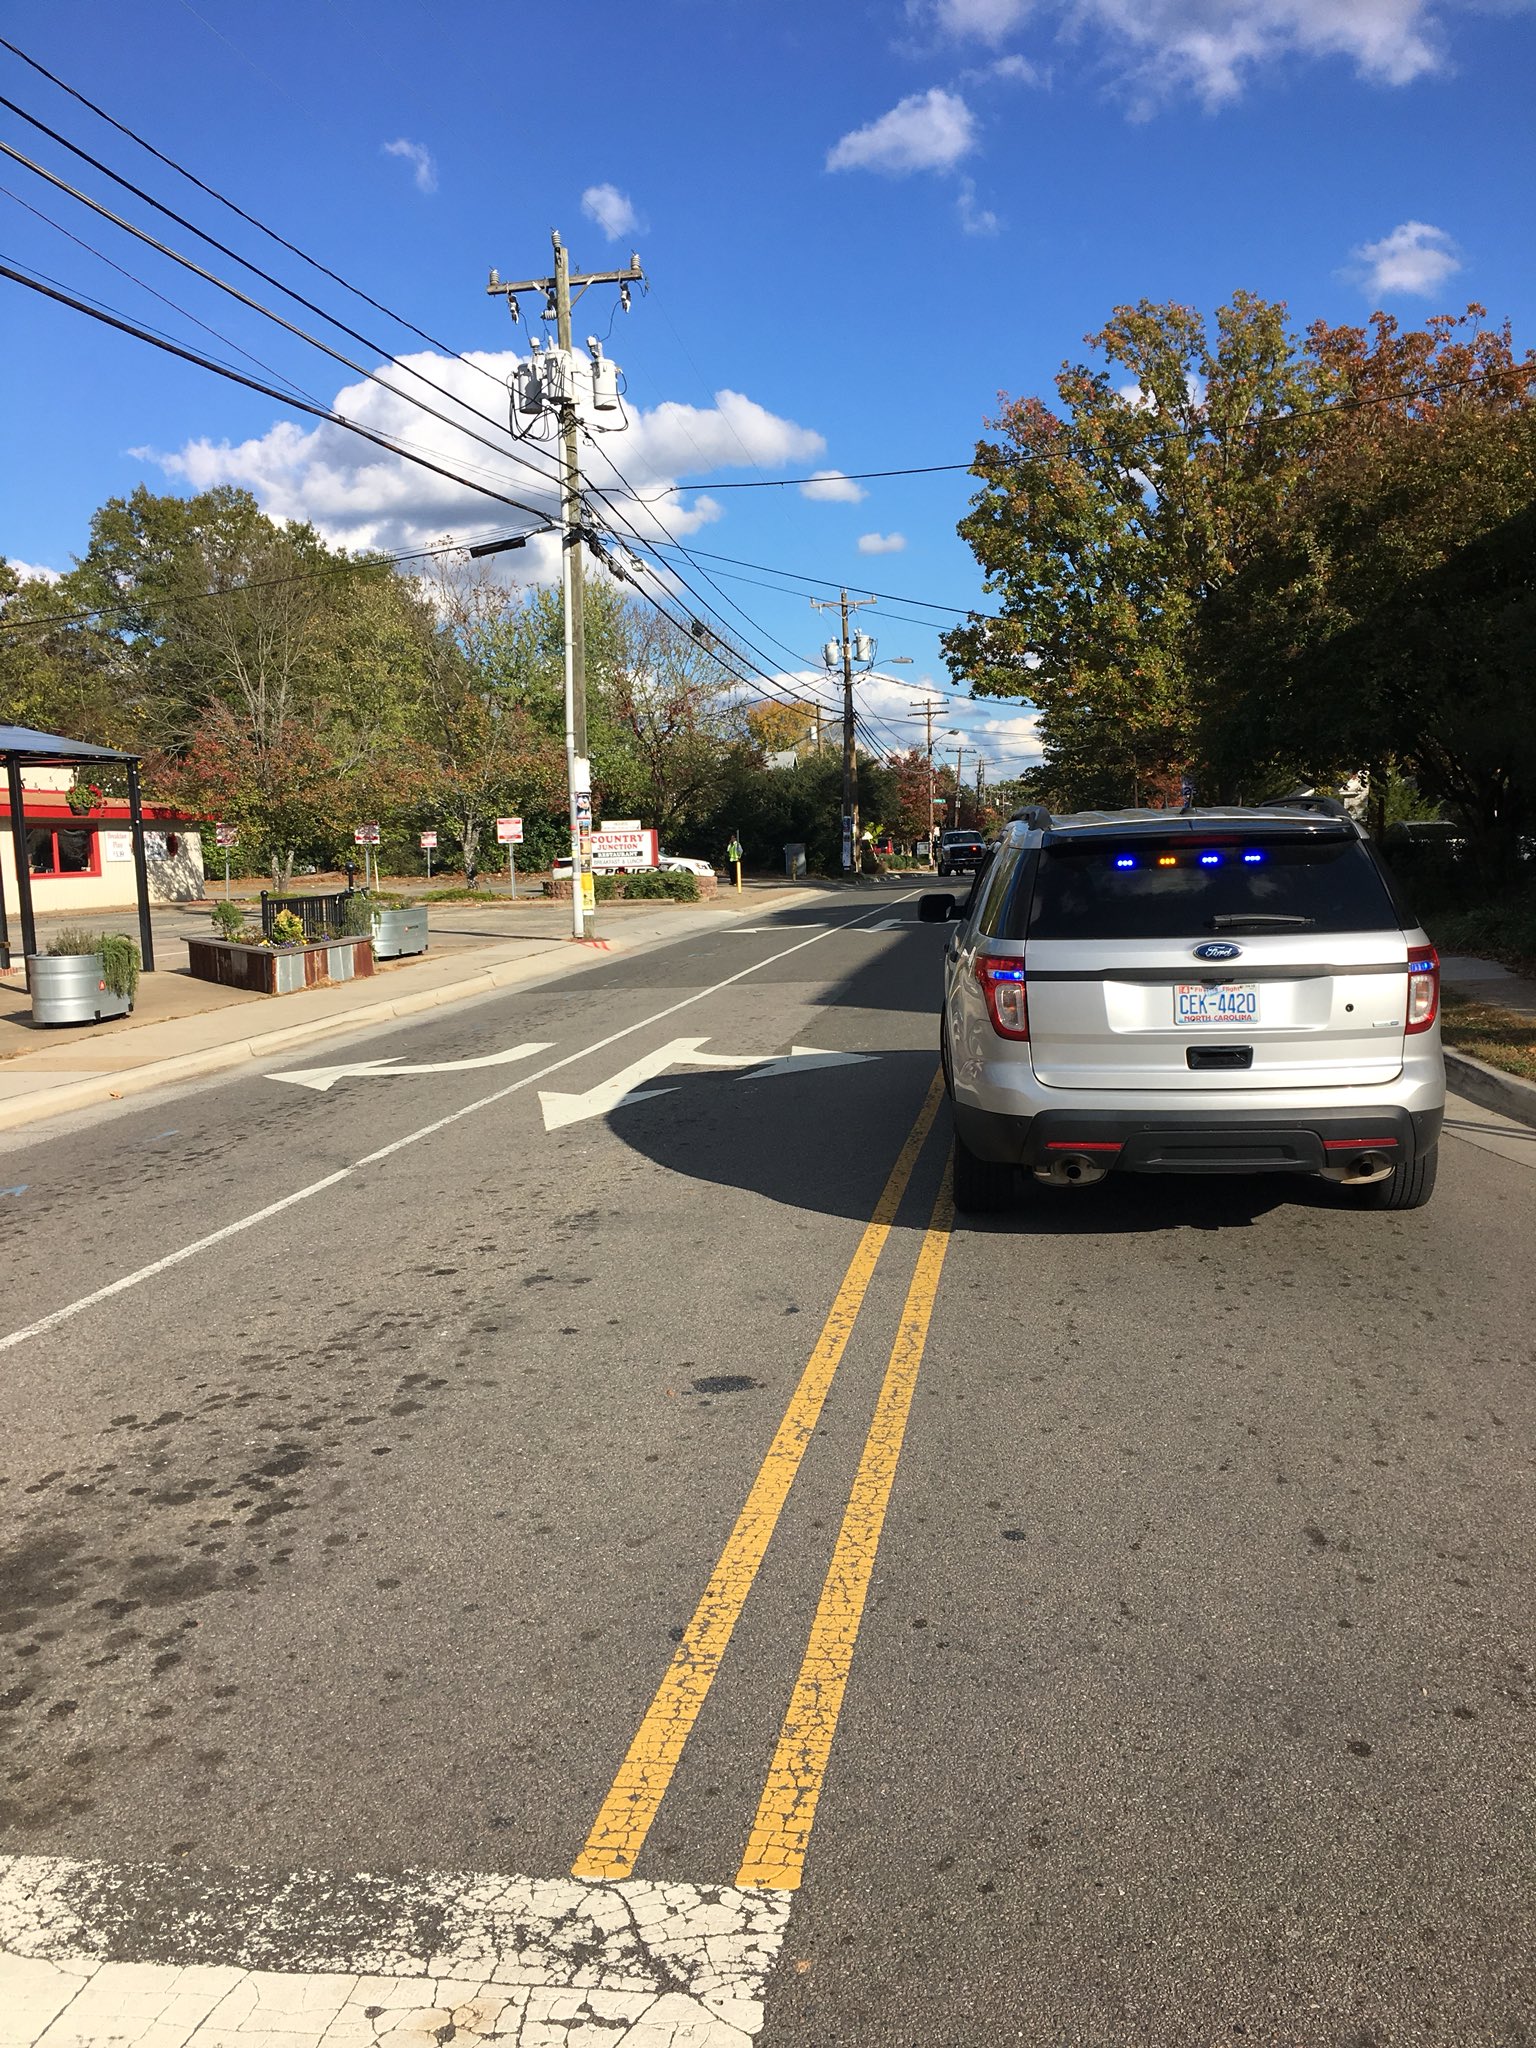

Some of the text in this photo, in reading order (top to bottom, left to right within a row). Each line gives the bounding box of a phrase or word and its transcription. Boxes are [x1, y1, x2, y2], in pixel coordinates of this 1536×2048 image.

[591, 834, 644, 844] COUNTRY
[1205, 945, 1233, 957] Ford
[1179, 992, 1256, 1014] CEK-4420
